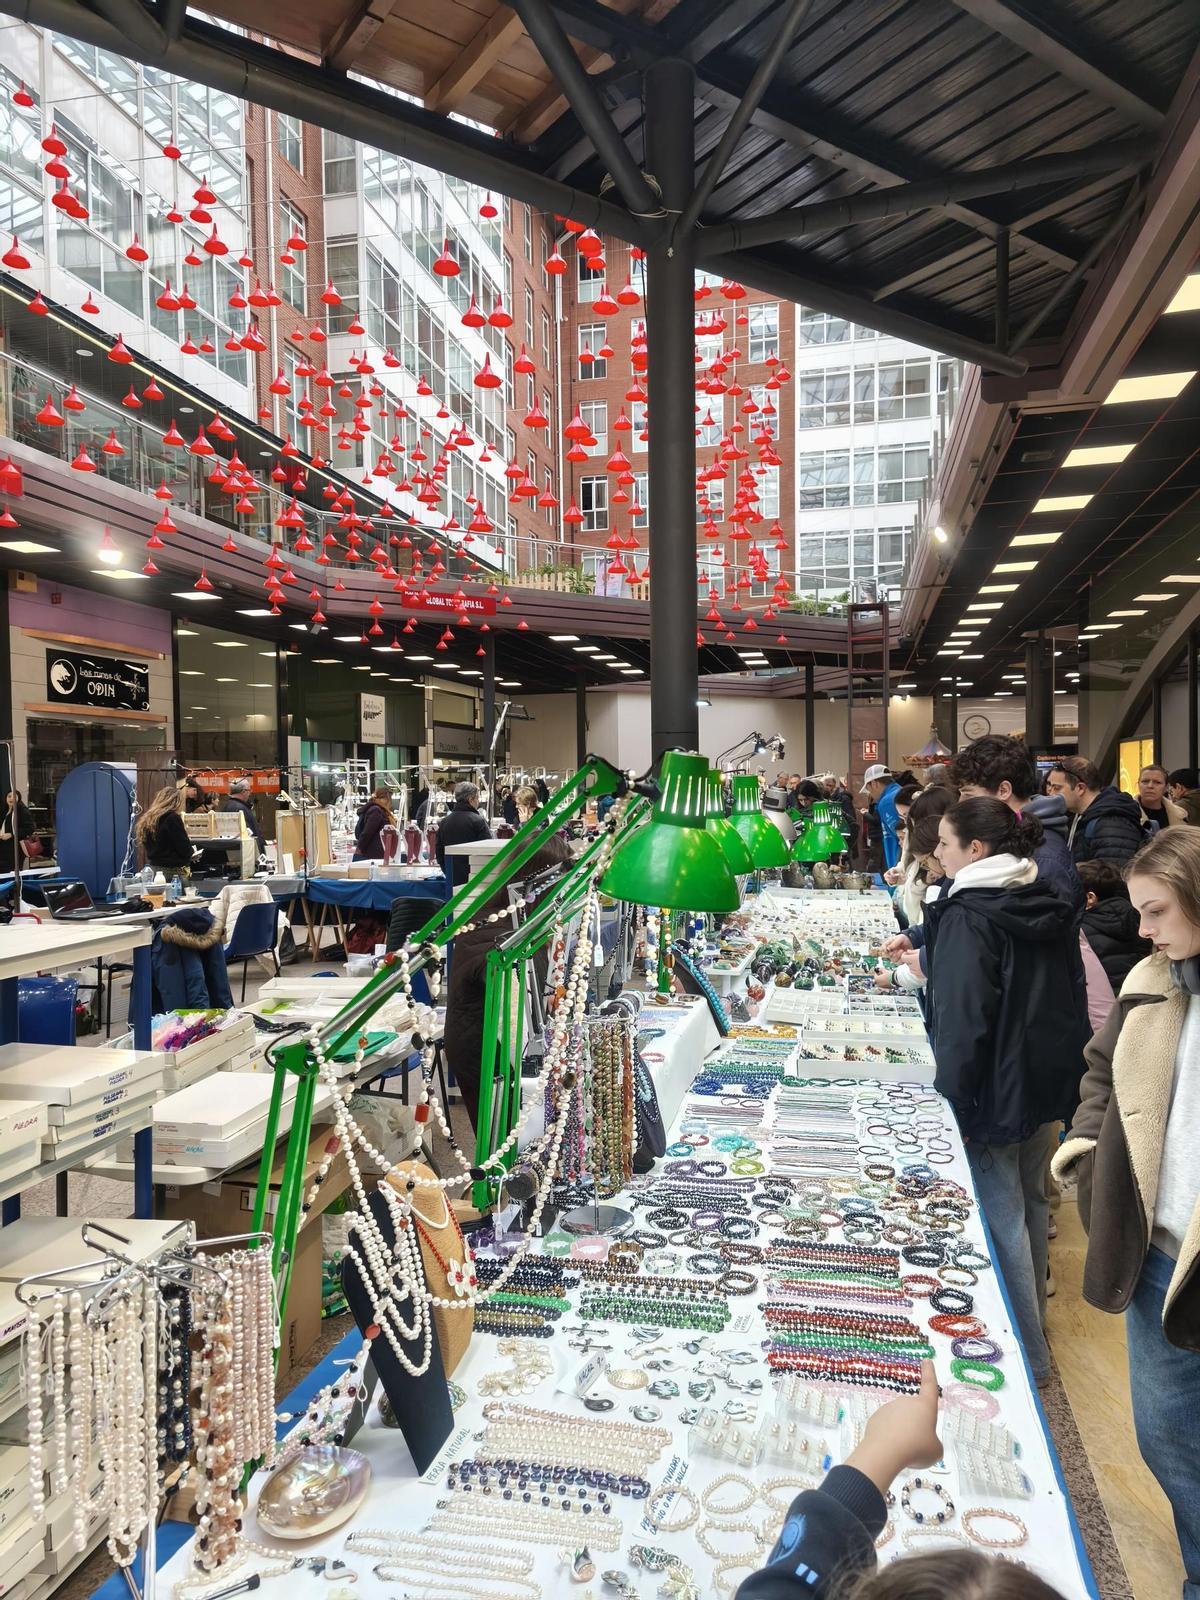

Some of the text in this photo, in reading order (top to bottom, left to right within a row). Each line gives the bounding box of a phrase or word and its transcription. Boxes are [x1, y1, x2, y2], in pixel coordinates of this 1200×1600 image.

[87, 681, 116, 698] ODIN
[13, 1116, 38, 1131] PIEDRA
[426, 1428, 471, 1481] PERLA NATURAL
